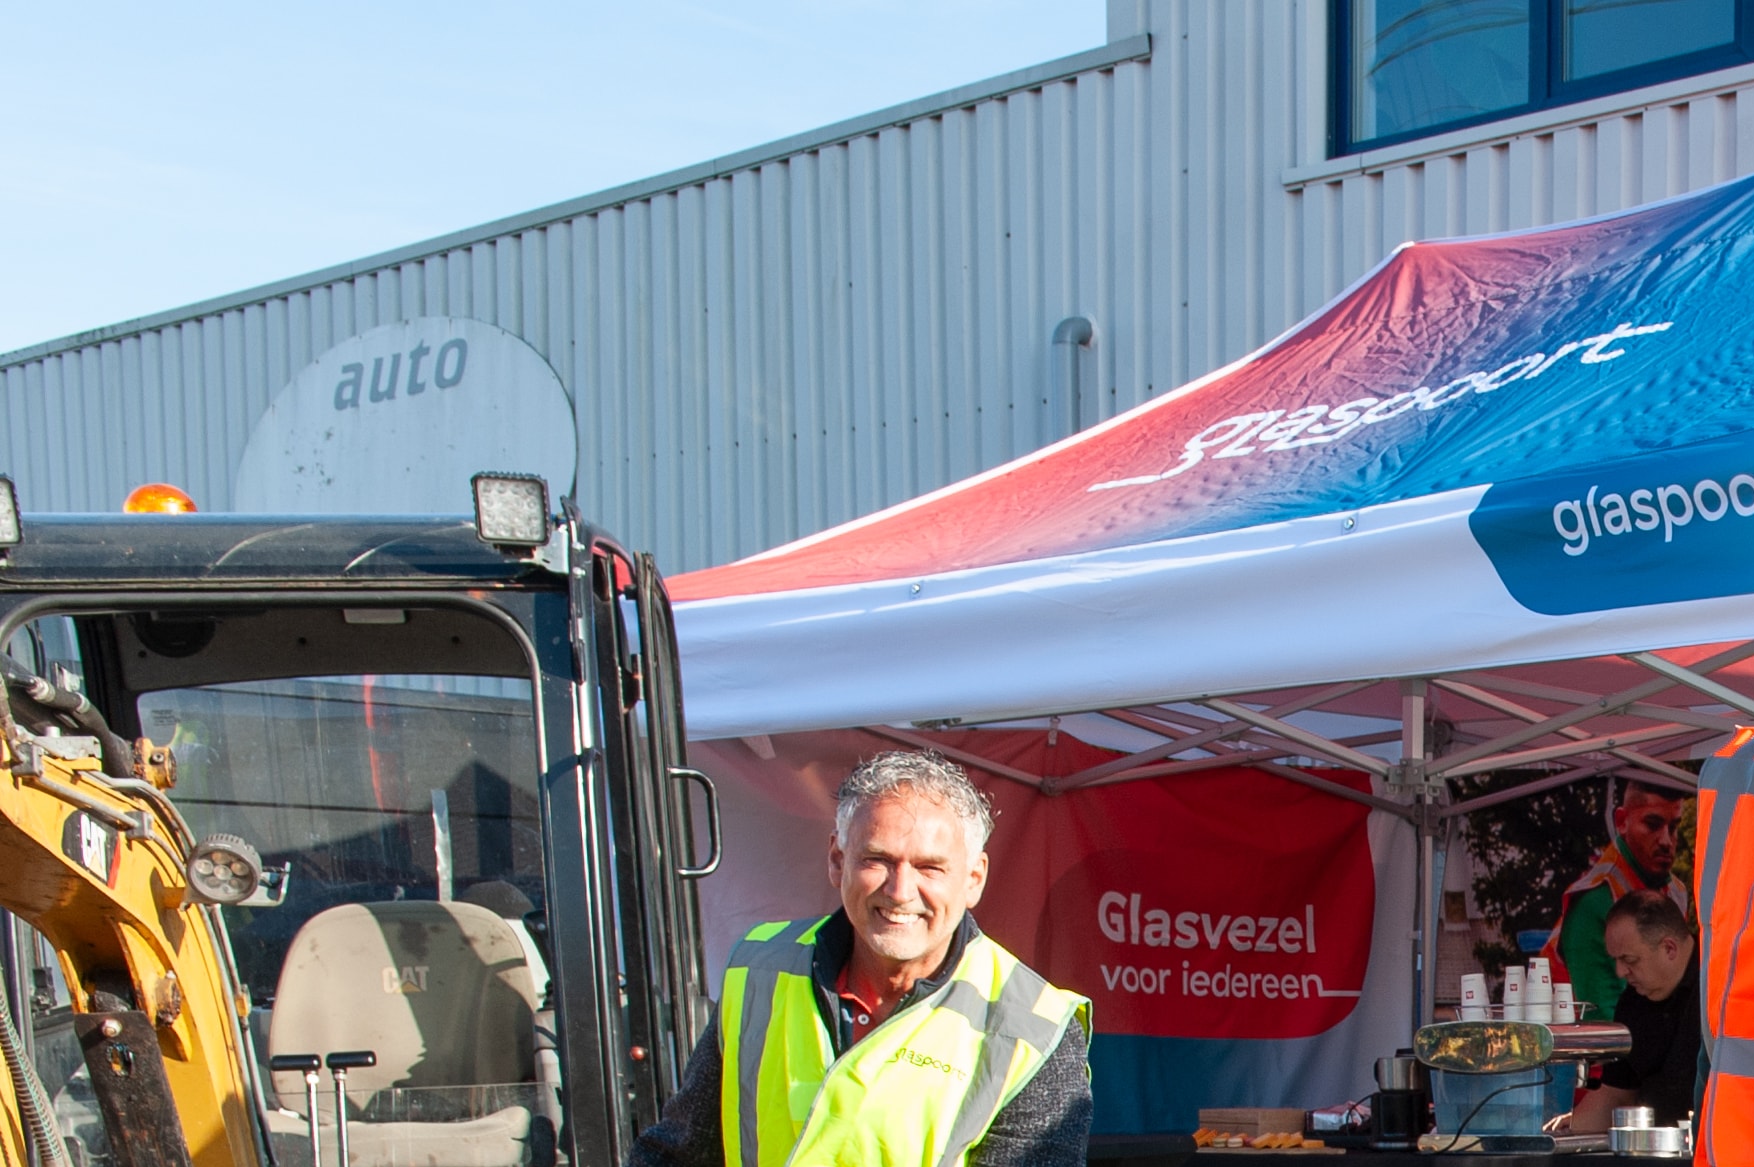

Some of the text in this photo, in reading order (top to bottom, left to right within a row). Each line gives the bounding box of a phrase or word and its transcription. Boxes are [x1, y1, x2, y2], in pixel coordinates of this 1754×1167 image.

[333, 338, 468, 411] auto
[1088, 320, 1674, 493] glaspoort
[1098, 890, 1317, 953] Glasvezel
[382, 966, 430, 994] CAT
[1101, 960, 1363, 999] voor iedereen
